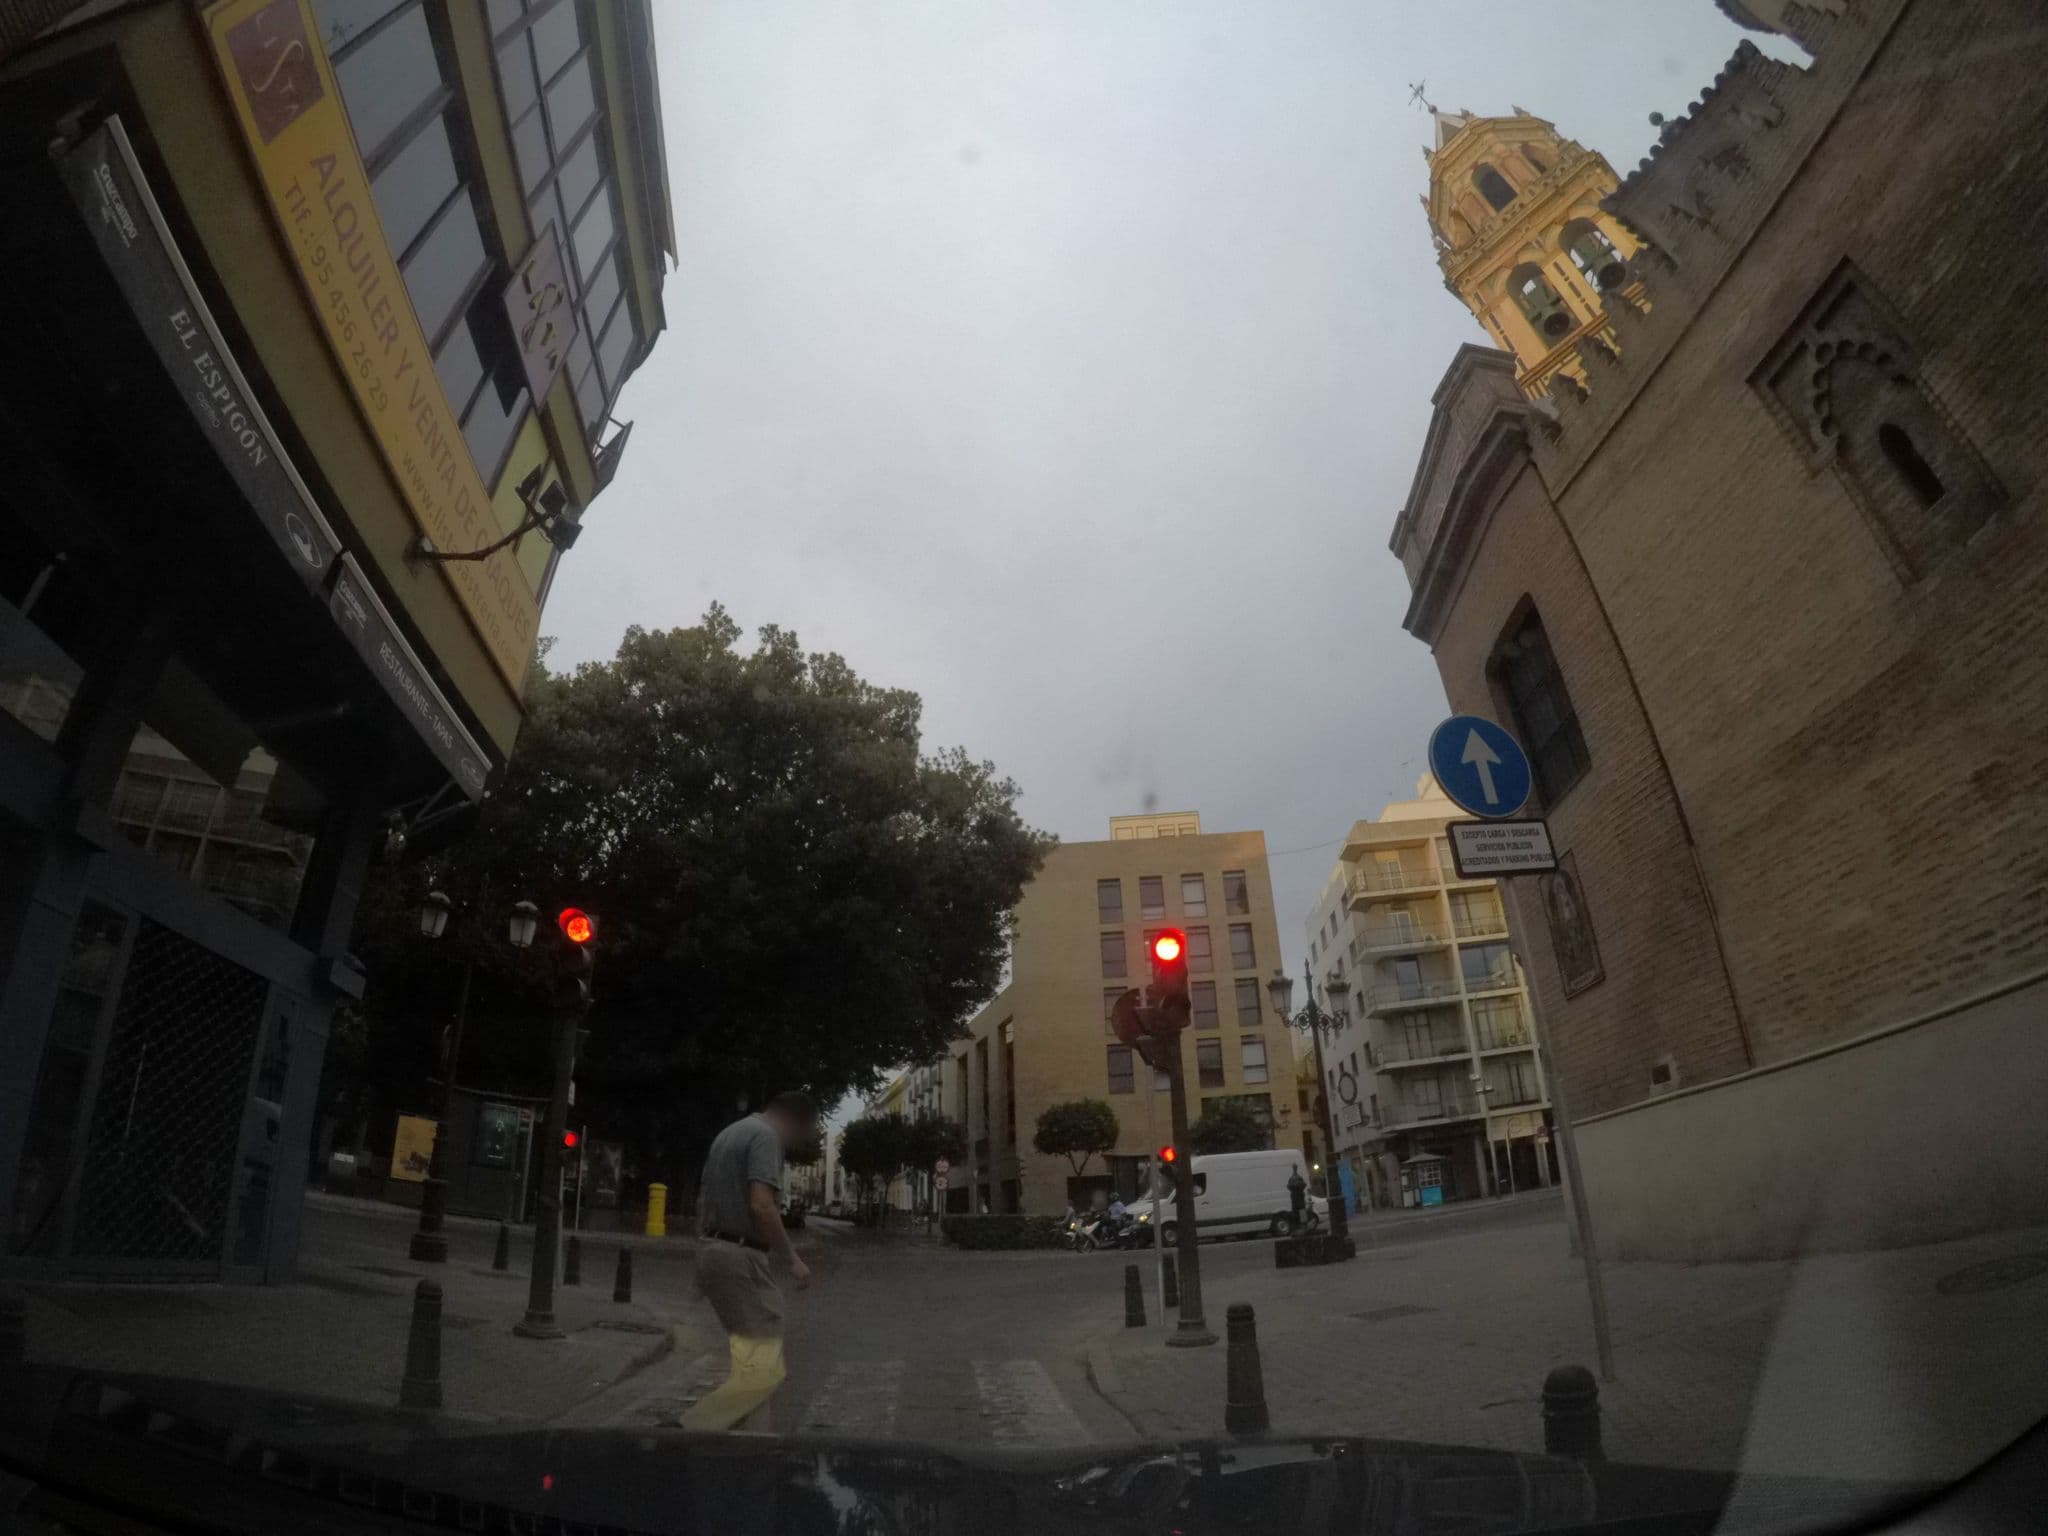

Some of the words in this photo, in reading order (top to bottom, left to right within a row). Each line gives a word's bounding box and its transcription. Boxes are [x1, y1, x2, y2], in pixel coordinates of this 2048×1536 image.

[168, 308, 198, 351] EL
[193, 351, 270, 467] ESPIGÓN
[309, 245, 335, 287] 95
[327, 289, 359, 343] 456
[349, 341, 374, 380] 26
[366, 377, 389, 413] 29
[310, 152, 400, 356] ALQUILER
[394, 348, 415, 381] Y
[407, 375, 457, 495] VENTA
[454, 486, 479, 532] DE
